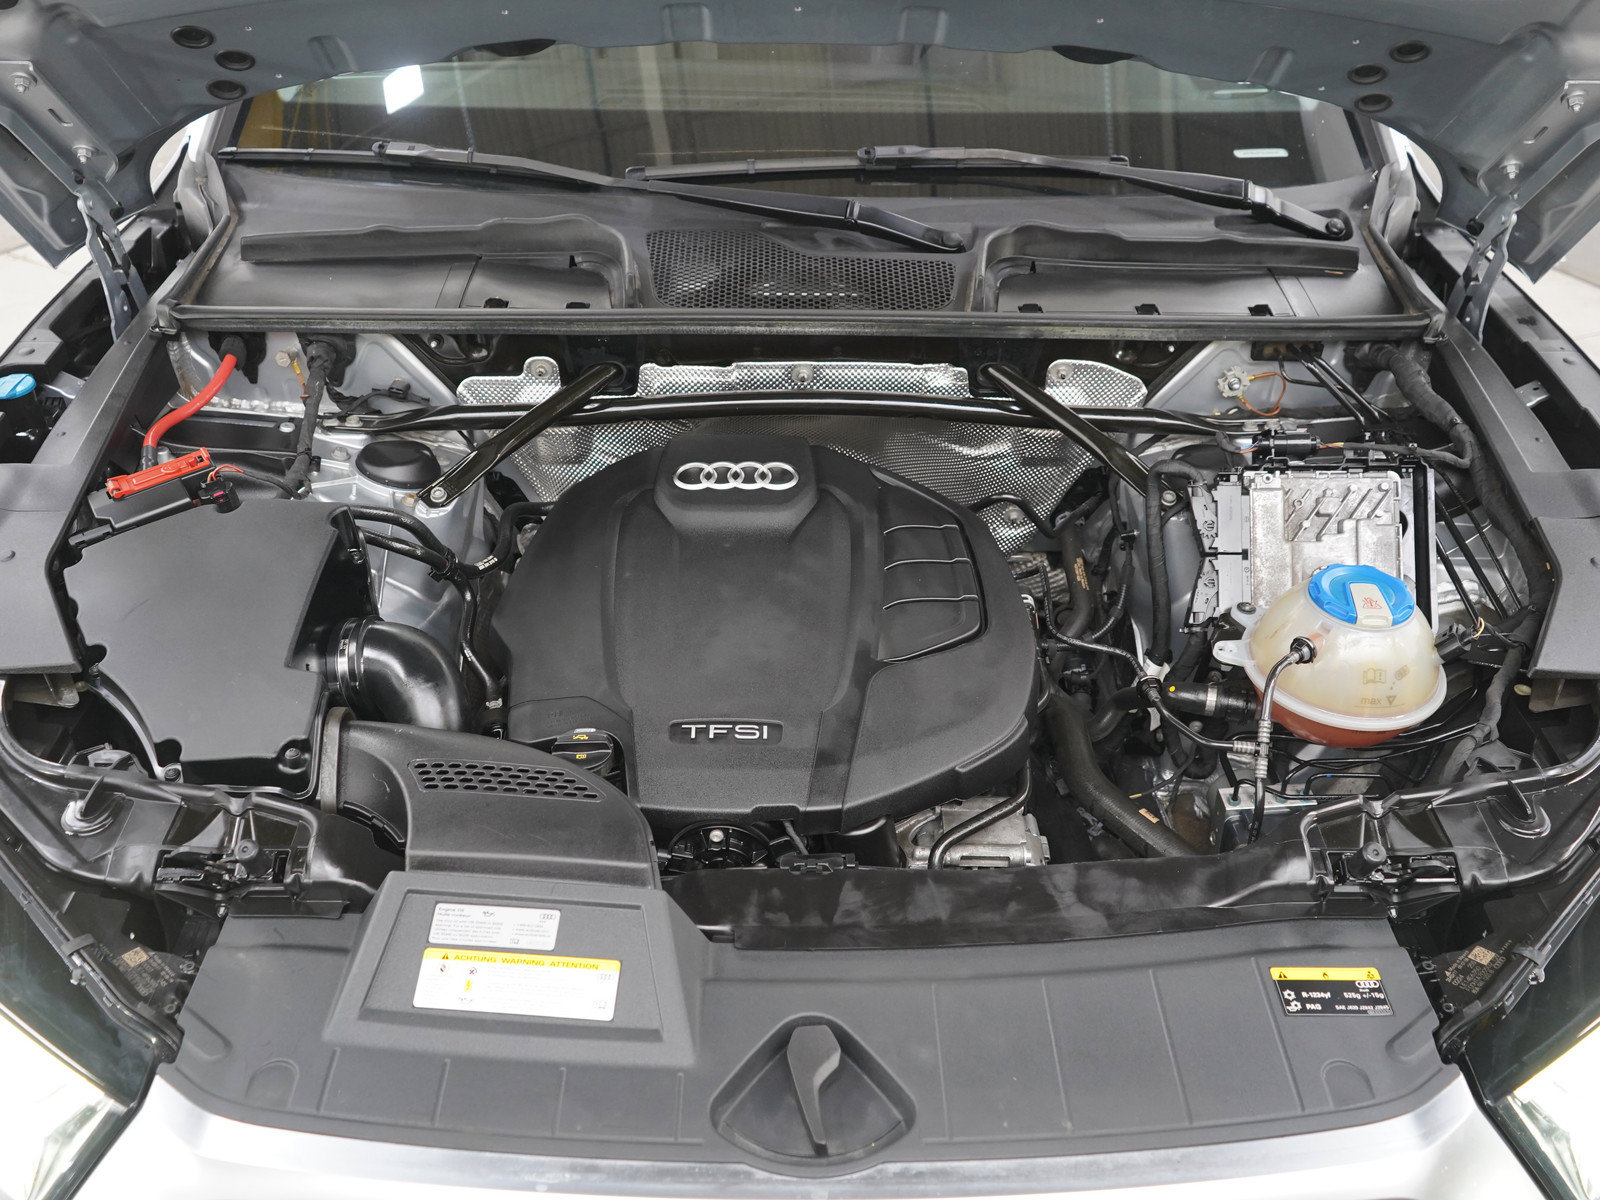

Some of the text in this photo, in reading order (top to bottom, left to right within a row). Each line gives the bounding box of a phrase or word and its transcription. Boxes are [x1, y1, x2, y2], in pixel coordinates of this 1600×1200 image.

[1360, 697, 1382, 705] max
[681, 724, 768, 740] TFSI
[453, 954, 599, 970] ACHTUNG WARNING ATTENTION
[1305, 1003, 1322, 1011] PAG
